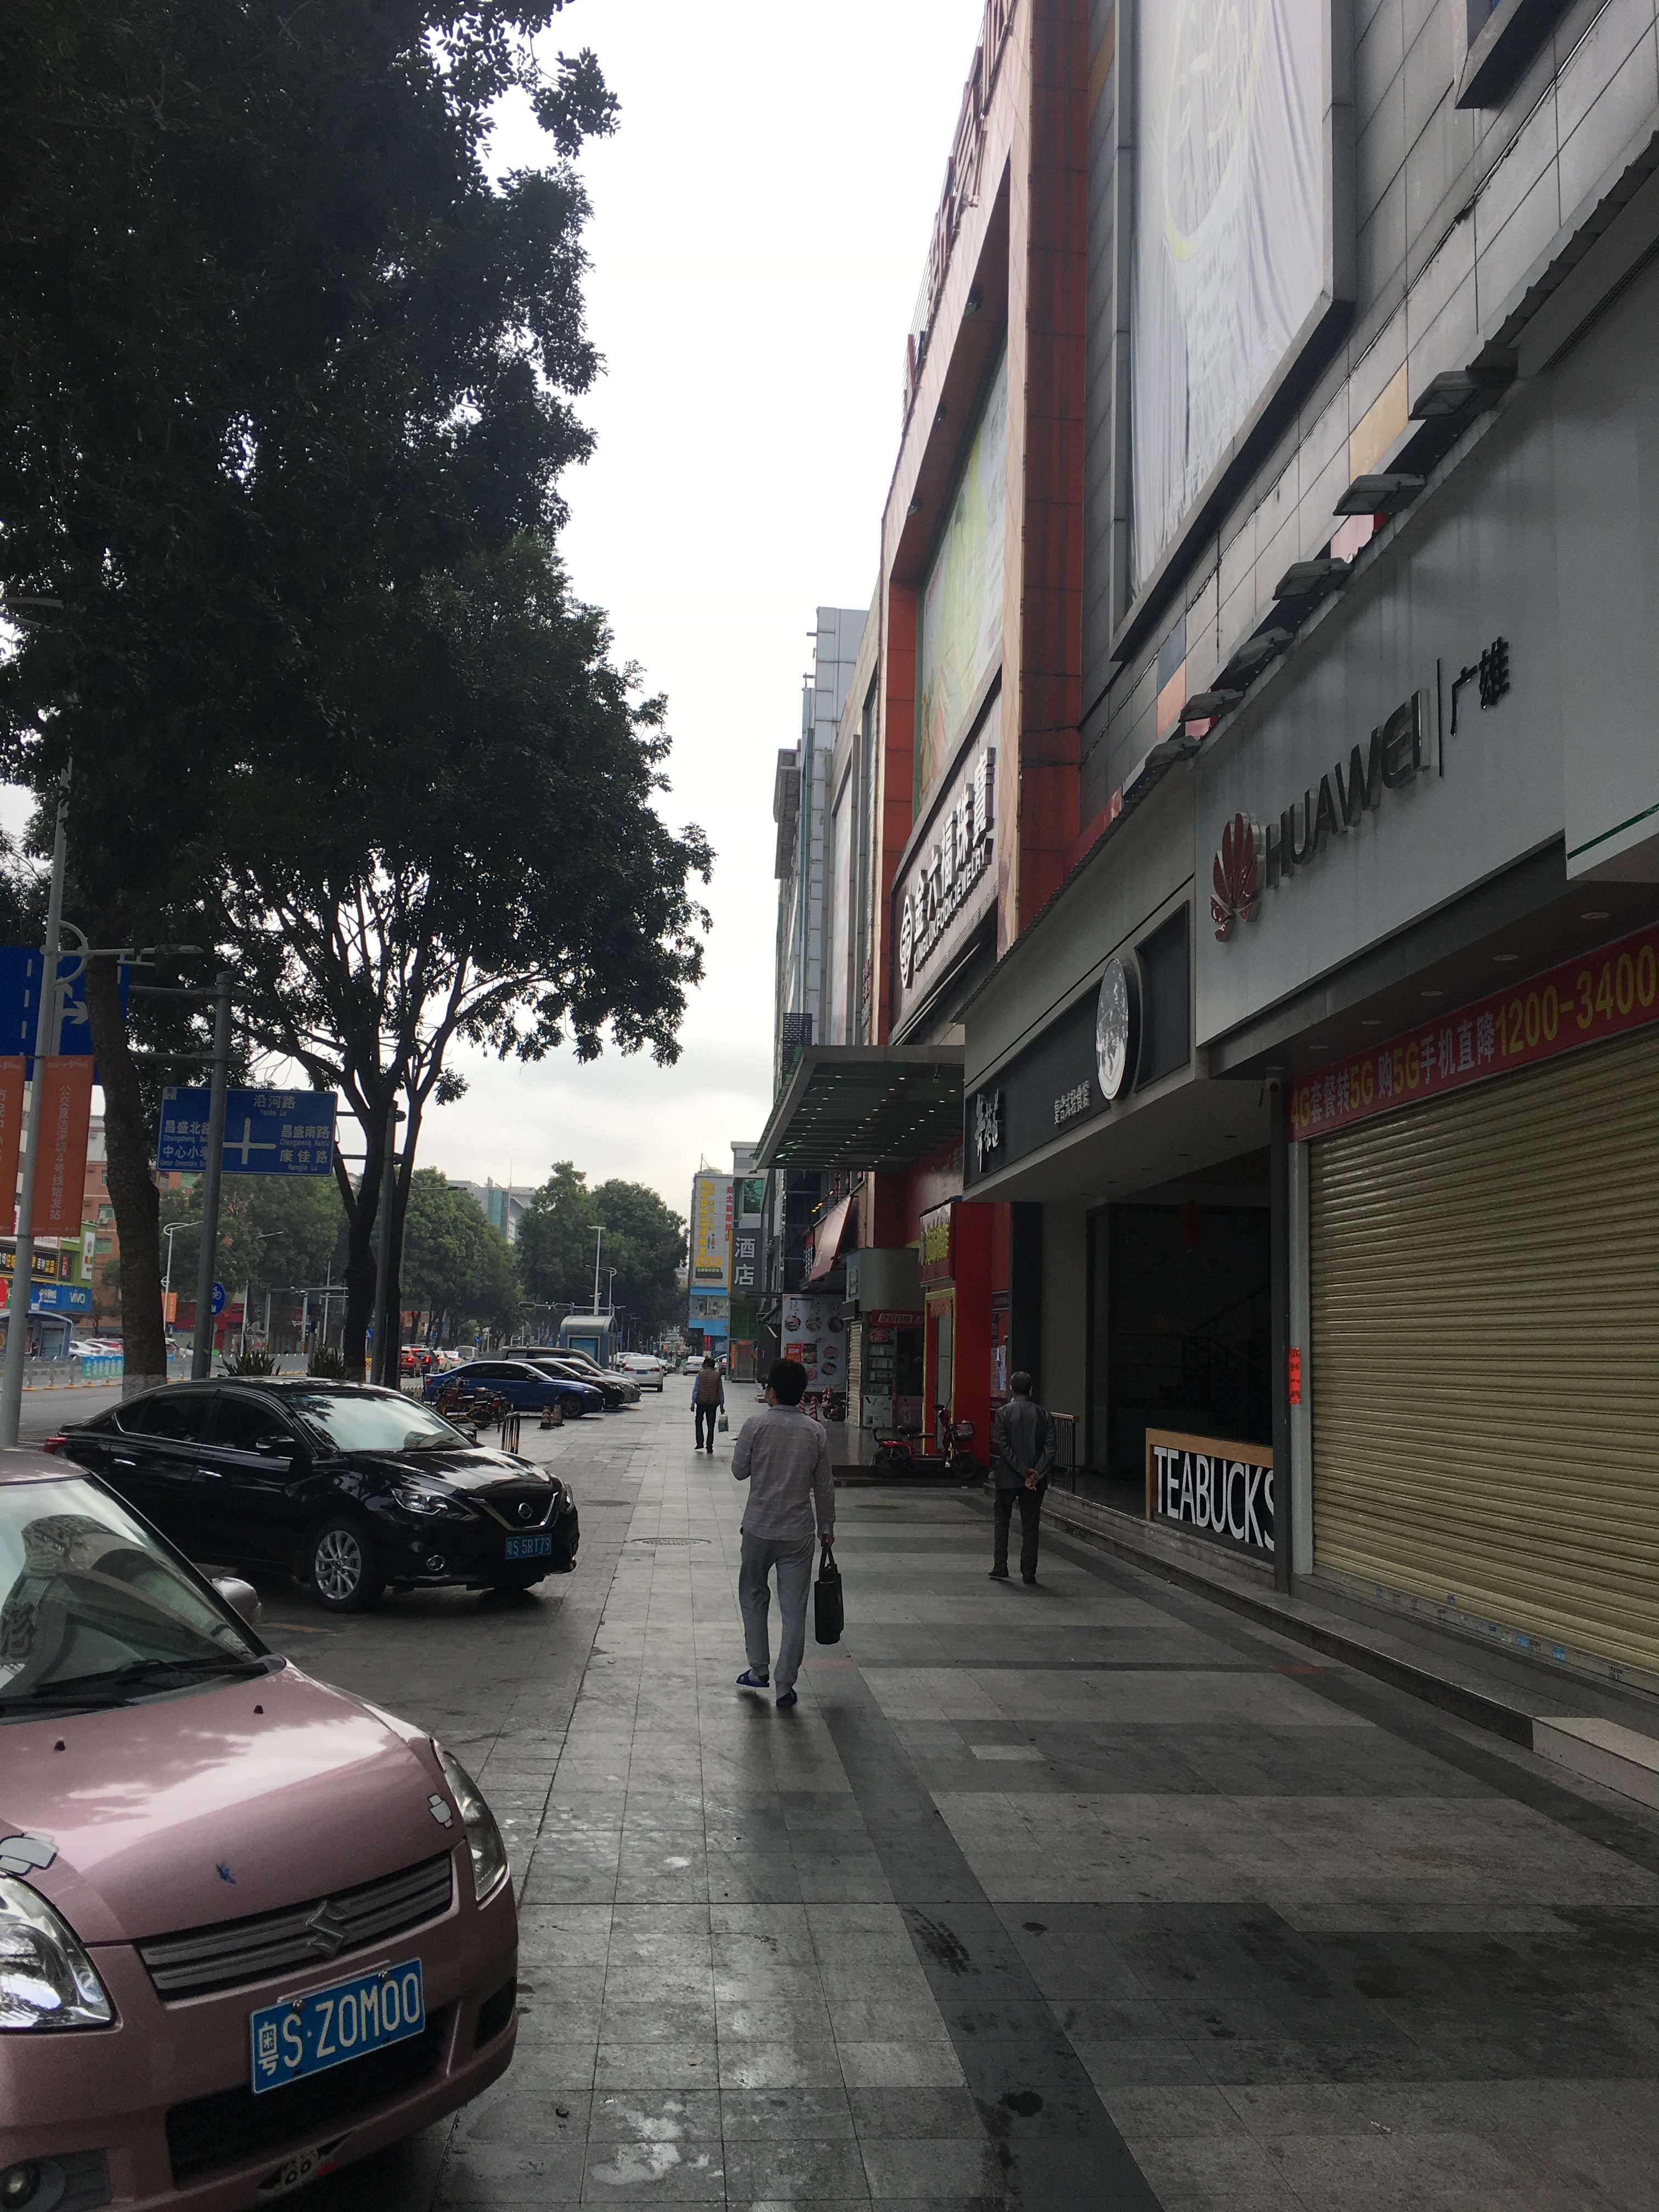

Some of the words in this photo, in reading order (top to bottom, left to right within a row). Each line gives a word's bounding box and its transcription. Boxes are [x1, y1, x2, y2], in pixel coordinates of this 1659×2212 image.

[1265, 689, 1426, 890] HUAWEI
[253, 1094, 296, 1109] 沿河路
[163, 1134, 195, 1143] Changsheng
[281, 1124, 330, 1139] 昌盛南路
[280, 1138, 311, 1148] Changsheng
[49, 1084, 71, 1221] 公交直达深圳4号线始发站
[279, 1149, 328, 1164] 康佳路
[733, 1236, 757, 1286] 酒店
[69, 1289, 86, 1305] vivo
